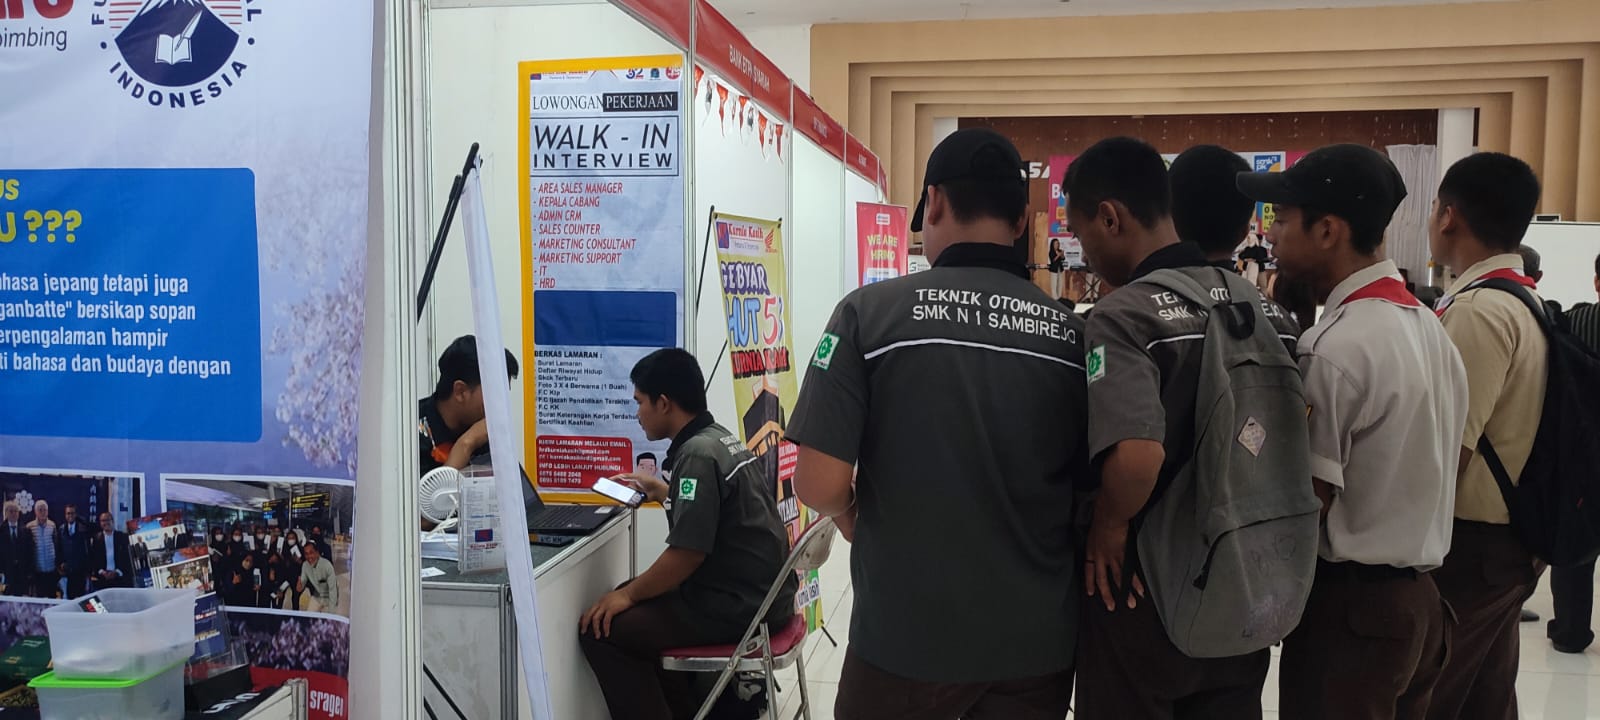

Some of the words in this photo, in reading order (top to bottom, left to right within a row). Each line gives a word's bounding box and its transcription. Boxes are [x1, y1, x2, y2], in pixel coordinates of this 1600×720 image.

[110, 60, 248, 108] INDONESIA
[533, 96, 604, 110] LOWONGAN
[606, 94, 673, 109] PEKERJAAN
[534, 124, 611, 150] WALK
[642, 124, 670, 148] IN
[534, 153, 672, 168] INTERVIEW
[538, 182, 558, 194] AREA
[560, 182, 582, 194] SALES
[585, 182, 623, 194] MANAGER
[538, 196, 566, 207] KEPALA
[569, 196, 600, 207] CABANG
[538, 210, 562, 221] ADMIN
[565, 210, 582, 221] CRM
[24, 210, 82, 243] ???
[539, 224, 561, 235] SALES
[564, 224, 600, 235] COUNTER
[539, 238, 584, 250] MARKETING
[586, 238, 636, 250] CONSULTANT
[867, 234, 880, 246] WE
[883, 234, 898, 248] ARE
[539, 252, 584, 264] MARKETING
[586, 252, 622, 264] SUPPORT
[540, 266, 547, 276] IT
[720, 261, 768, 291] GEBYAR
[0, 272, 39, 291] hasa
[44, 273, 99, 296] jepang
[103, 274, 148, 296] tetapi
[154, 274, 188, 296] juga
[539, 278, 556, 288] HRD
[77, 300, 145, 323] bersikap
[150, 304, 196, 324] sopan
[915, 288, 982, 306] TEKNIK
[989, 294, 1068, 322] OTOMOTIF
[1158, 305, 1194, 320] SMK
[912, 305, 950, 321] SMK
[957, 307, 969, 324] N
[976, 310, 981, 326] 1
[988, 313, 1076, 344] SAMBIREJO
[112, 327, 168, 350] hampir
[13, 352, 66, 372] bahasa
[72, 354, 102, 372] dan
[107, 354, 164, 378] budaya
[168, 355, 231, 379] dengan
